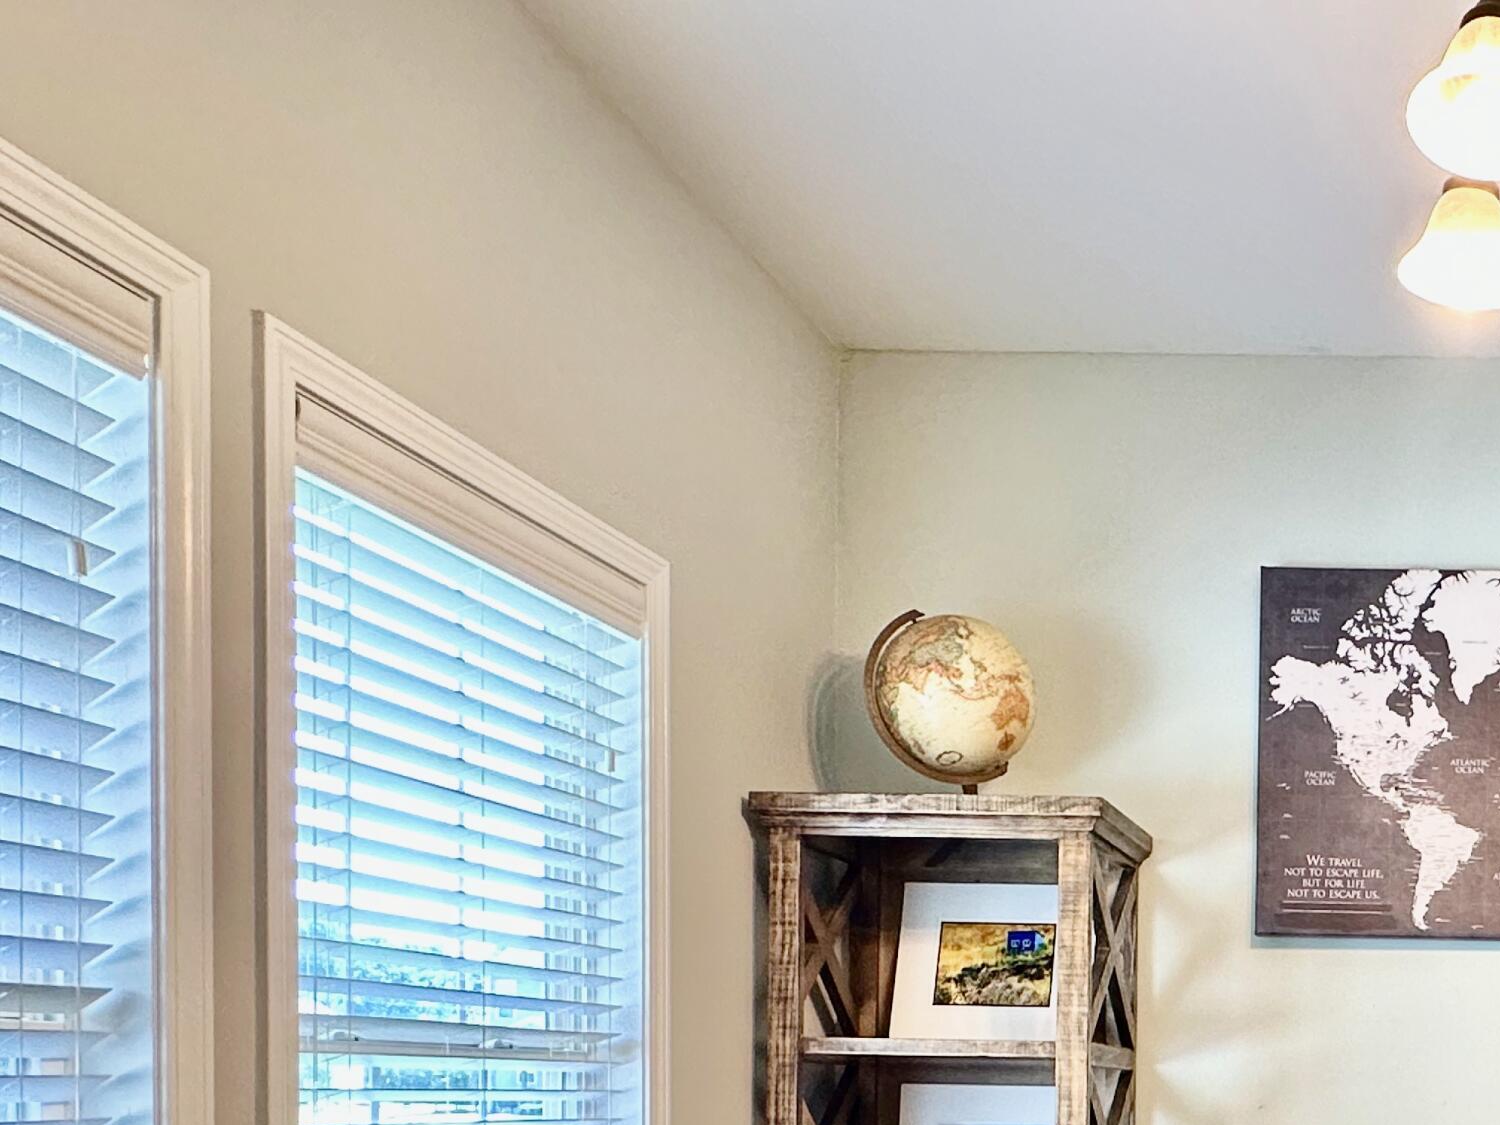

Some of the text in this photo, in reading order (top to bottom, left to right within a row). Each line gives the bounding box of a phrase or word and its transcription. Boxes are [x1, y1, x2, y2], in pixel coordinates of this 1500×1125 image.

[1290, 615, 1320, 623] OCEAN
[1455, 766, 1484, 774] OCEAN
[1306, 778, 1335, 786] OCEAN
[1328, 857, 1362, 867] TRAVEL
[1283, 867, 1306, 877] NOT
[1309, 867, 1323, 877] TO
[1326, 867, 1359, 878] ESCAPE
[1302, 878, 1366, 889] BUT FOR LIFE
[1286, 888, 1309, 898] NOT
[1312, 888, 1326, 898] TO
[1329, 888, 1362, 899] ESCAPE
